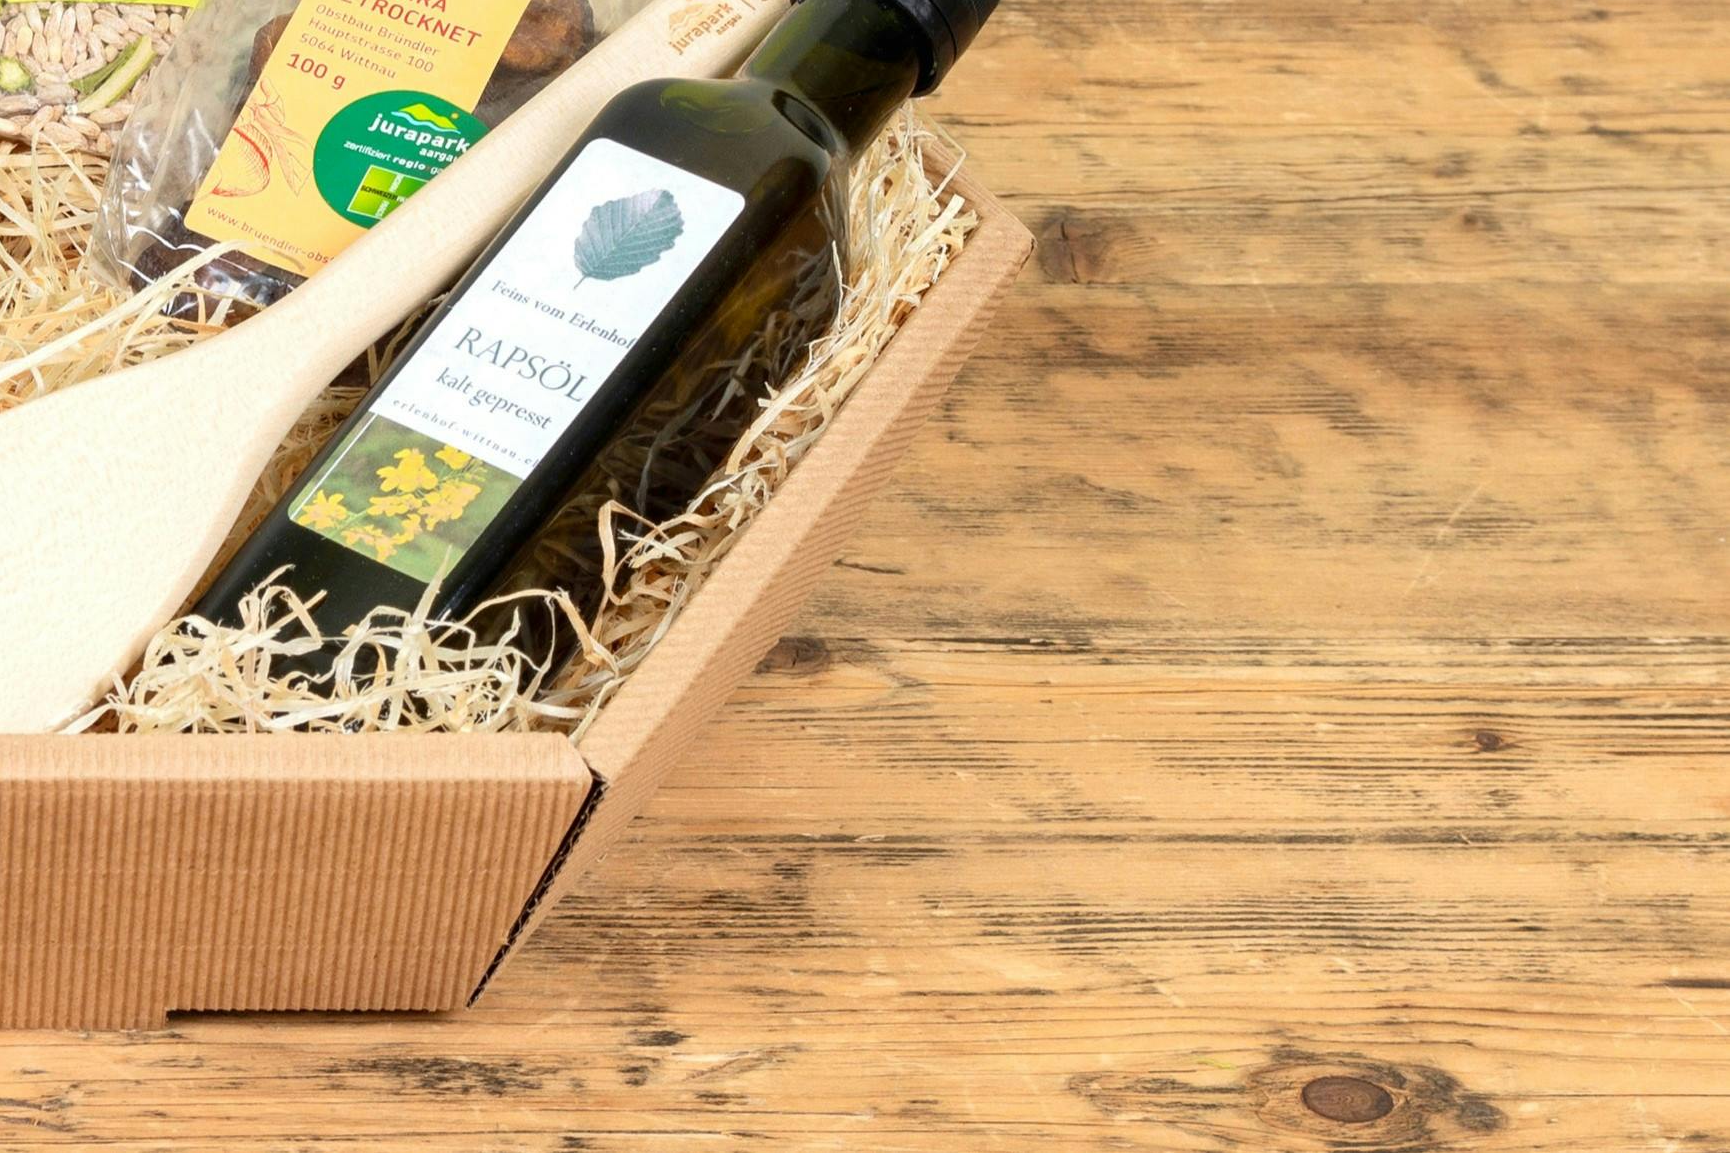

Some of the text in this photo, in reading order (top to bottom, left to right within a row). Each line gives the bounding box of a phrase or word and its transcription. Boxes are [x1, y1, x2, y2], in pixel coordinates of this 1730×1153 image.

[300, 33, 398, 79] 5064 Wittnau
[308, 17, 435, 74] Hauptstrasse 100
[316, 4, 440, 57] Obstbau Bründler
[668, 2, 734, 56] jurapark
[286, 53, 346, 91] 100 g
[367, 113, 471, 153] jurapark
[491, 279, 638, 349] Feins vom Erlenhof
[454, 326, 589, 403] RAPSÖL
[436, 366, 553, 431] kalt gepresst
